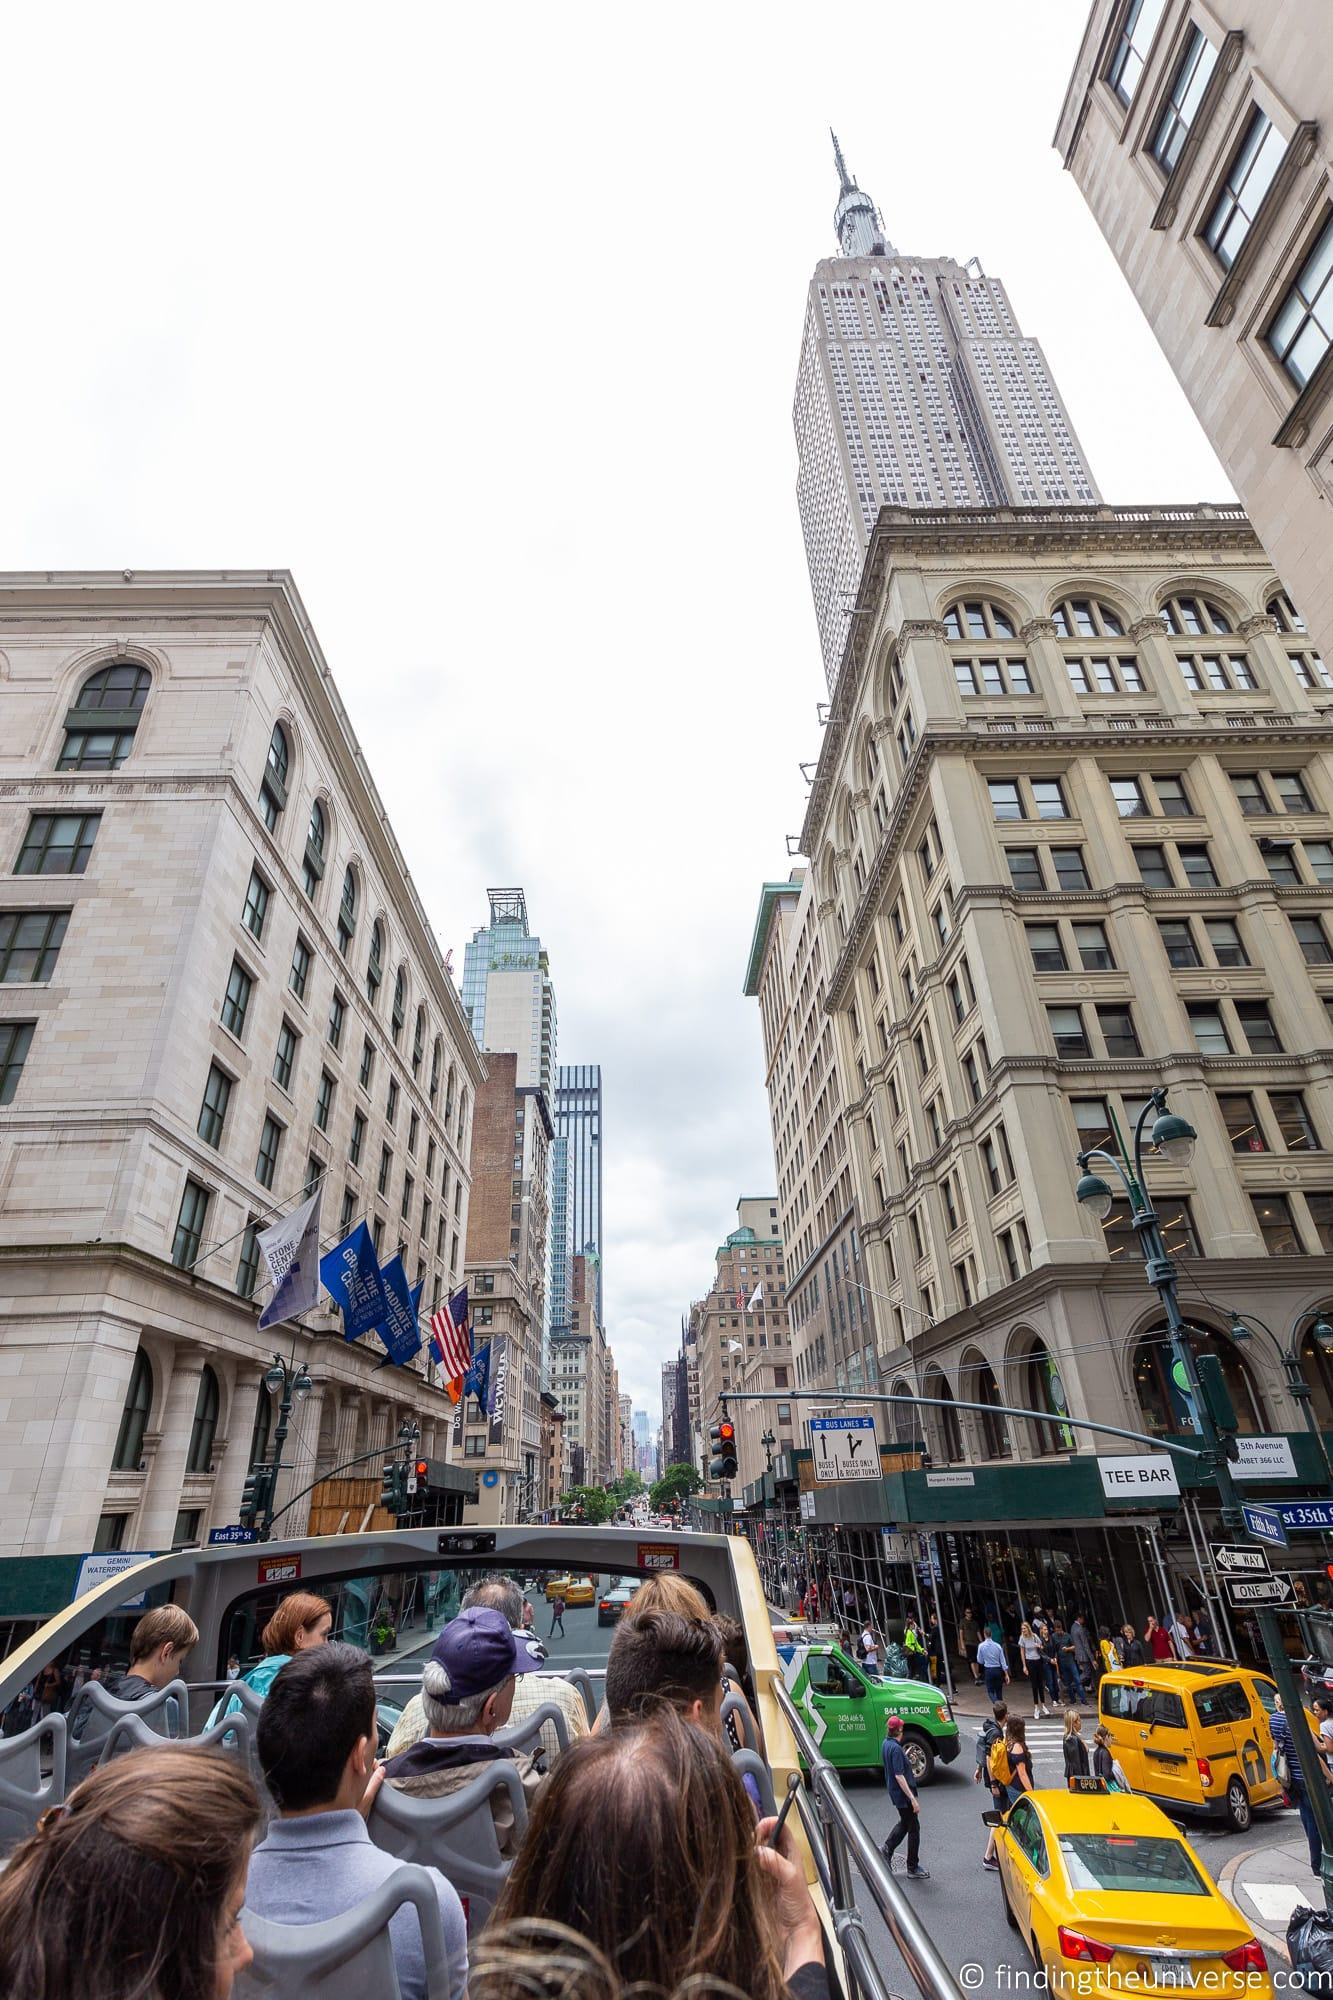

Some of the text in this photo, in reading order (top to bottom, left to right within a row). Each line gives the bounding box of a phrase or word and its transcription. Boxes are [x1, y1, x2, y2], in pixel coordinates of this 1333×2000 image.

[268, 1240, 296, 1262] STONE
[271, 1248, 297, 1270] CENTE
[364, 1271, 380, 1298] THE
[453, 1416, 461, 1429] Do
[825, 1420, 860, 1429] BUS LANES
[1240, 1442, 1283, 1450] 5th Avenue
[842, 1460, 859, 1468] BUSES
[1273, 1456, 1285, 1464] LLC
[818, 1461, 835, 1469] BUSES
[821, 1470, 834, 1478] ONLY
[845, 1469, 861, 1477] RIGHT
[862, 1468, 879, 1476] TURNS
[1105, 1468, 1172, 1484] TEE BAR
[1282, 1511, 1297, 1524] st
[1296, 1508, 1328, 1524] 35th
[1249, 1514, 1279, 1537] Fifth Ave
[214, 1532, 229, 1541] East
[244, 1531, 252, 1540] St
[106, 1557, 131, 1565] GEMINI
[1220, 1553, 1260, 1566] ONE WAY
[87, 1565, 133, 1574] WATERPRO
[1240, 1583, 1285, 1597] ONE WAY
[910, 1705, 931, 1714] LOGIX
